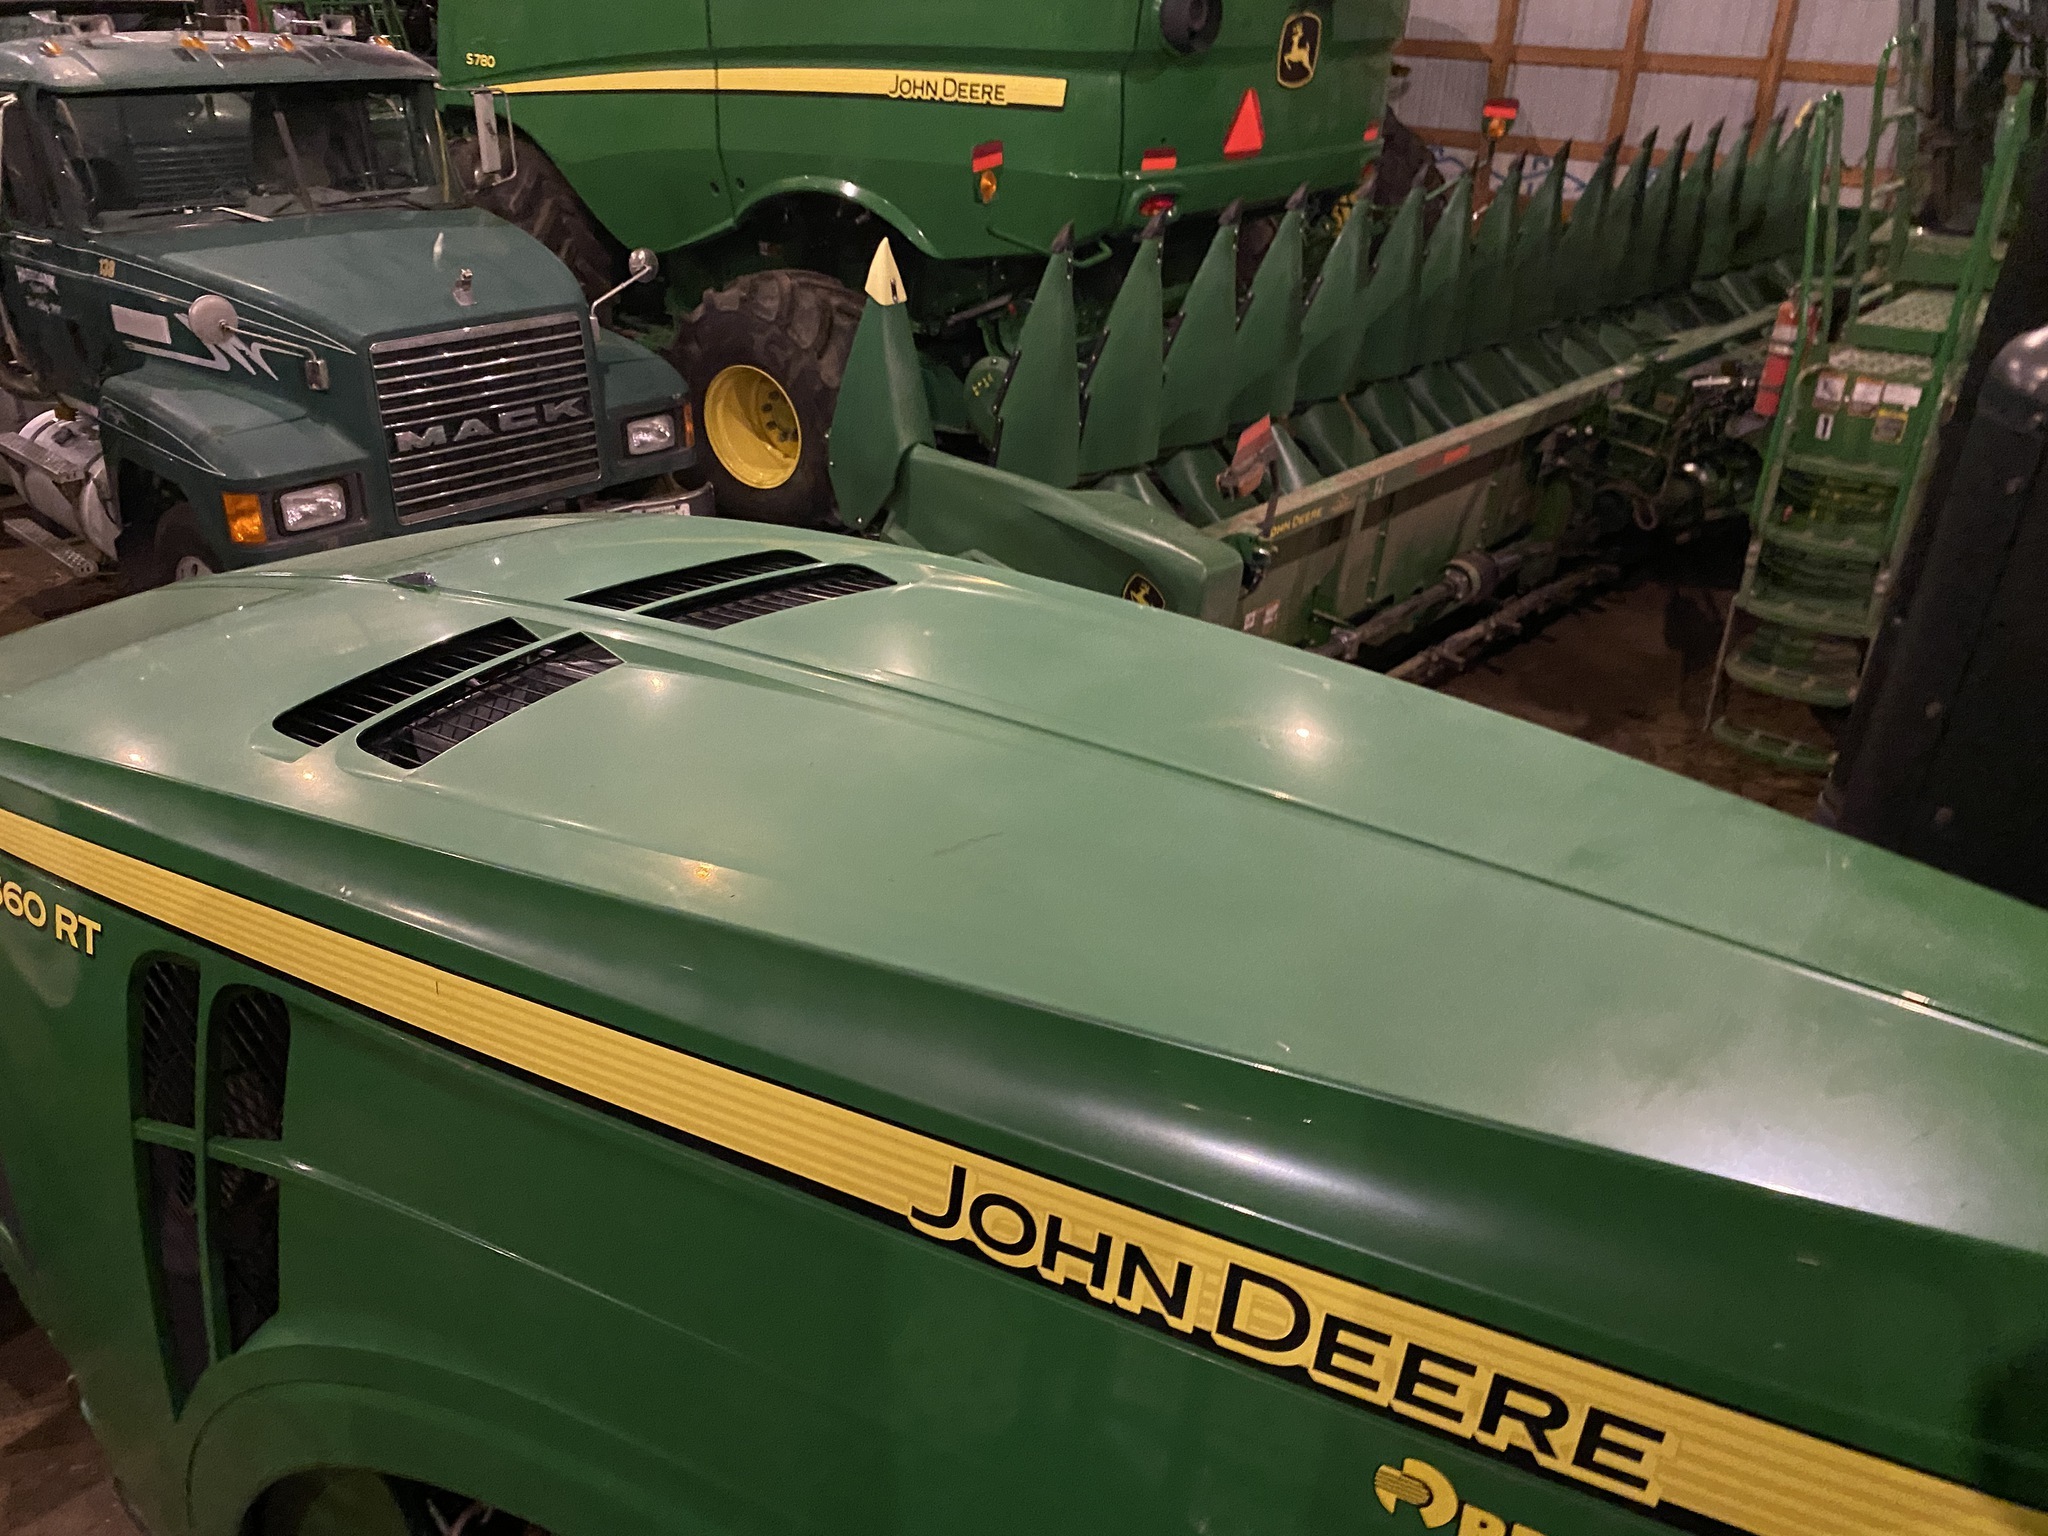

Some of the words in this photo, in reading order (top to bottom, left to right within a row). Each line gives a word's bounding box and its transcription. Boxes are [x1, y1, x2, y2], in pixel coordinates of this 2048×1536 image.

[465, 52, 496, 68] S780
[889, 74, 938, 96] JOHN
[943, 77, 1006, 101] DEERE
[395, 397, 584, 451] MACK
[0, 876, 47, 927] 60
[55, 903, 101, 955] RT
[910, 1164, 1194, 1321] JOHN
[1215, 1261, 1666, 1493] DEERE
